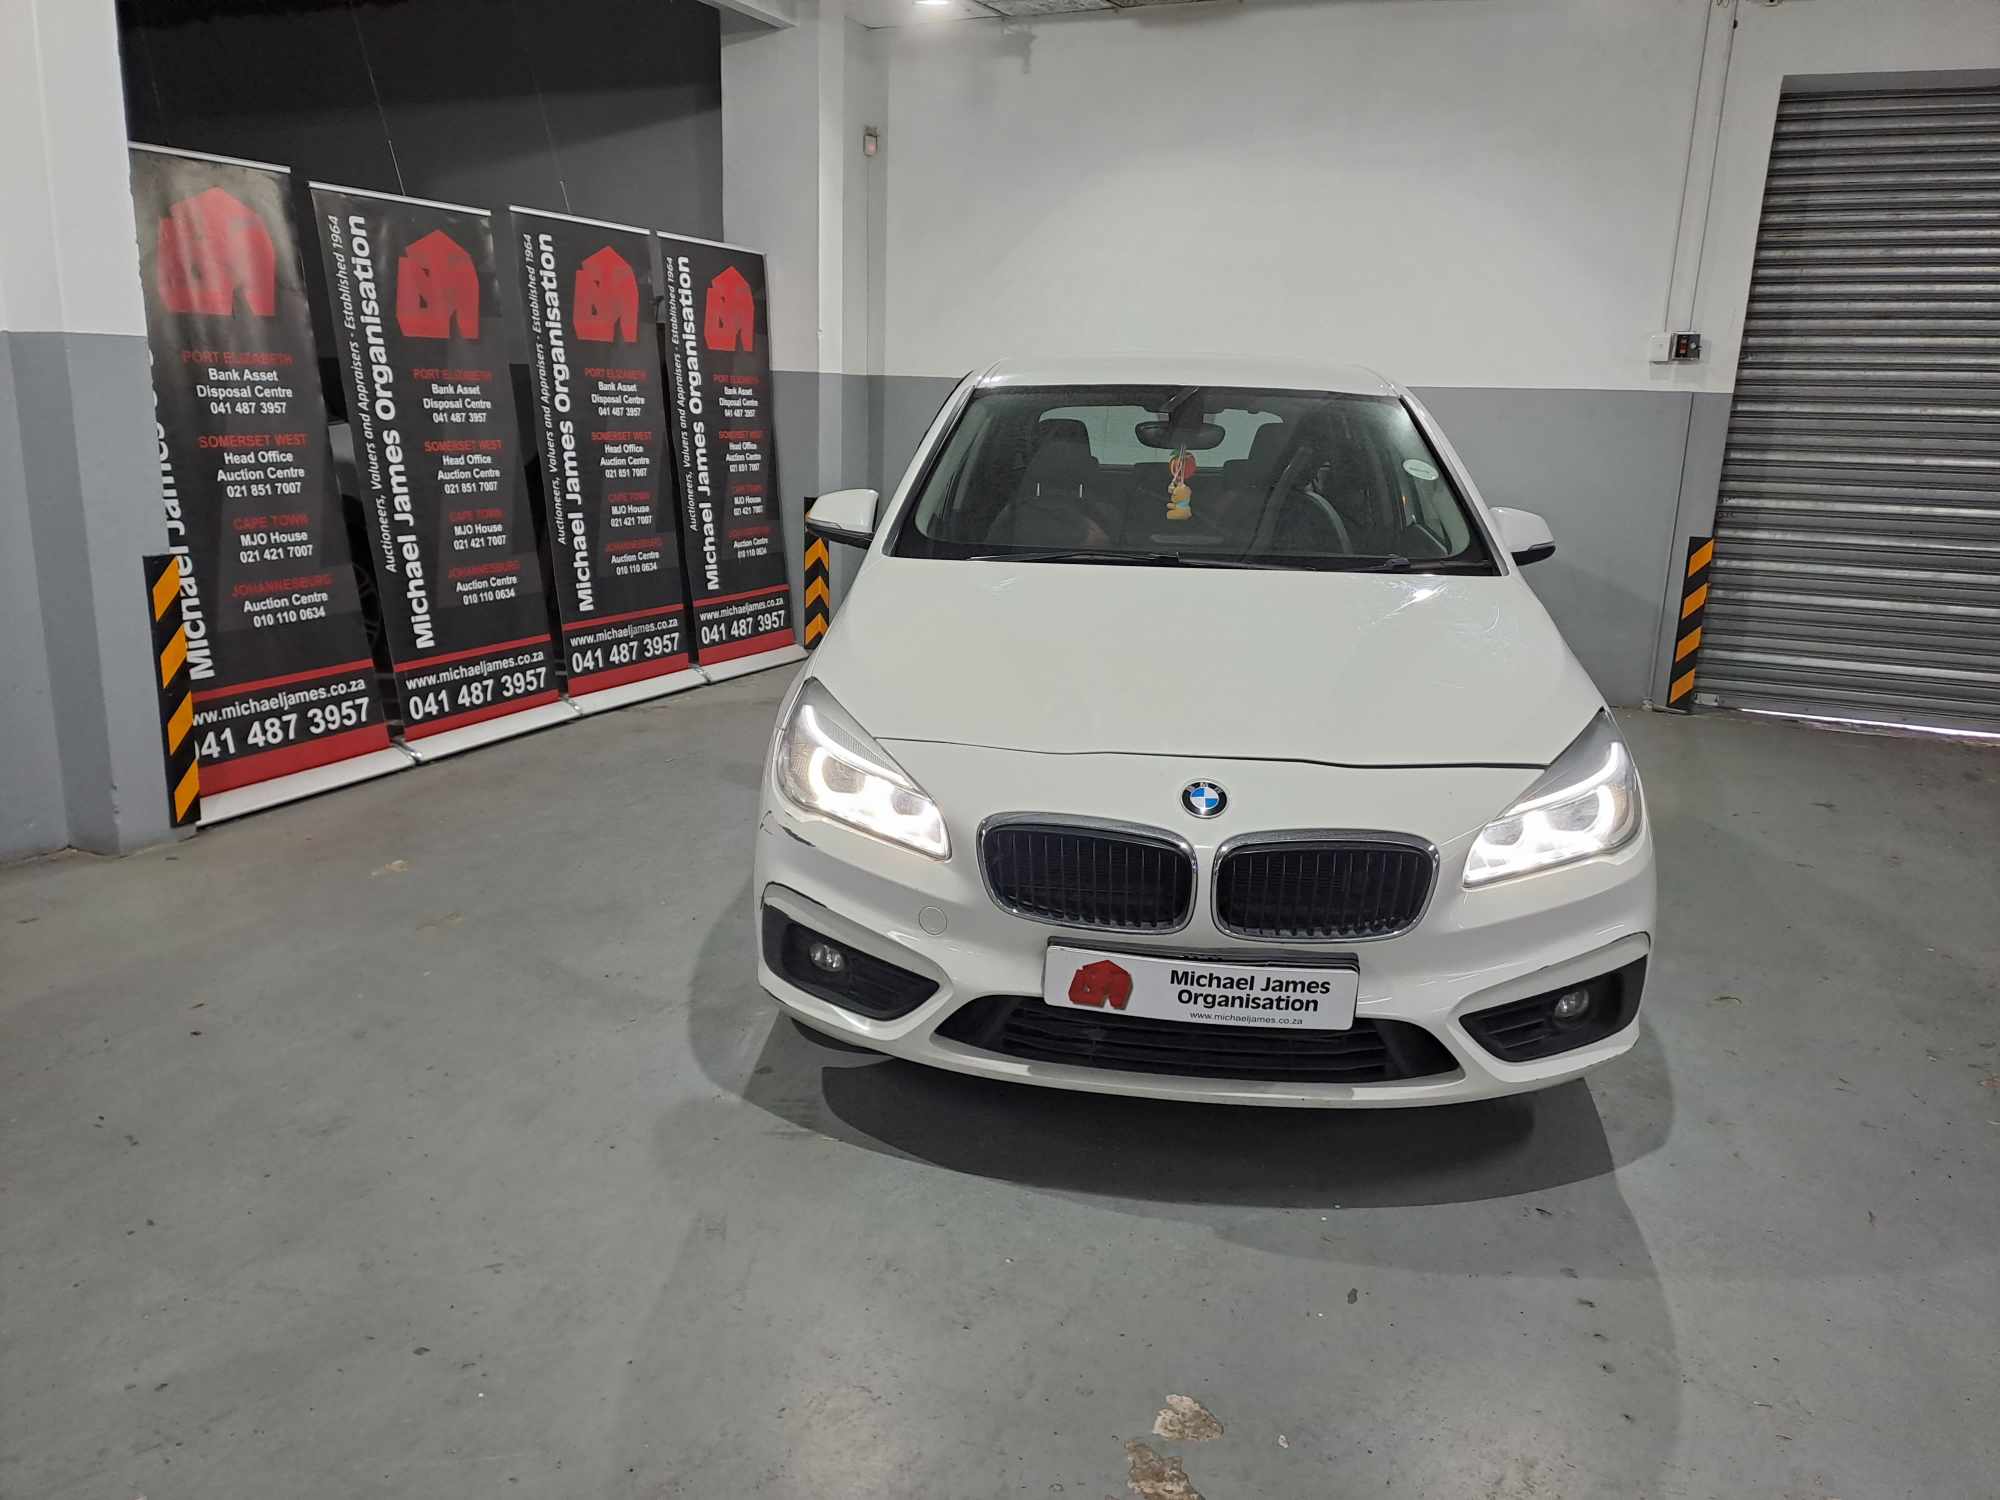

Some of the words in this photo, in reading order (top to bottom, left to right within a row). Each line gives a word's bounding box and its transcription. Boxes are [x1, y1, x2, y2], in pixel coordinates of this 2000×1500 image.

[328, 214, 343, 249] 1964
[523, 233, 534, 263] 1964
[333, 251, 356, 329] Established
[526, 265, 542, 333] Established
[349, 215, 397, 421] Organisation
[538, 233, 571, 413] Organisation
[678, 256, 703, 415] Organisation
[182, 351, 219, 364] PORT
[208, 368, 240, 381] Bank
[243, 369, 279, 381] Asset
[350, 341, 369, 411] Appraisers
[536, 343, 550, 404] Appraisers
[196, 385, 252, 400] Disposal
[255, 386, 293, 398] Centre
[432, 383, 455, 394] Bank
[457, 384, 480, 394] Asset
[210, 402, 232, 414] 041
[235, 402, 256, 414] 487
[260, 402, 287, 414] 3957
[423, 398, 462, 410] Disposal
[358, 412, 373, 438] and
[433, 413, 448, 423] 041
[541, 405, 553, 429] and
[677, 408, 687, 429] and
[199, 434, 272, 448] SOMERSET
[275, 433, 307, 447] WEST
[546, 431, 558, 473] Valuers
[681, 431, 691, 468] Valuers
[224, 452, 255, 464] Head
[258, 451, 294, 463] Office
[366, 441, 382, 490] Valuers
[442, 455, 465, 465] Head
[466, 454, 492, 464] Office
[560, 420, 583, 505] James
[693, 421, 711, 496] James
[217, 468, 264, 482] Auction
[267, 467, 305, 479] Centre
[383, 429, 414, 527] James
[438, 469, 471, 480] Auction
[227, 485, 247, 498] 021
[251, 484, 272, 497] 851
[275, 482, 302, 495] 7007
[444, 483, 459, 494] 021
[551, 477, 567, 545] Auctioneers,
[240, 533, 267, 546] MJO
[270, 531, 308, 544] House
[375, 494, 398, 573] Auctioneers,
[454, 525, 473, 536] MJO
[475, 523, 503, 534] House
[240, 550, 260, 563] 021
[263, 548, 284, 560] 421
[287, 544, 313, 558] 7007
[453, 540, 468, 550] 021
[470, 537, 485, 548] 421
[699, 502, 719, 591] Michael
[568, 512, 594, 612] Michael
[397, 534, 435, 649] Michael
[456, 579, 488, 592] Auction
[479, 591, 494, 602] 110
[243, 597, 289, 613] Auction
[291, 592, 328, 606] Centre
[700, 597, 784, 621] www.michaeljames.co.za
[253, 614, 274, 628] 010
[276, 610, 297, 624] 110
[299, 606, 326, 621] 0634
[701, 622, 726, 644] 041
[731, 617, 753, 637] 487
[757, 610, 785, 632] 3957
[570, 618, 678, 647] www.michaeljames.co.za
[572, 648, 604, 673] 041
[609, 641, 638, 664] 487
[643, 632, 680, 657] 3957
[406, 651, 544, 690] www.michaeljames.co.za
[192, 678, 366, 727] ww.michaeljames.co.za
[409, 689, 450, 720] 041
[457, 679, 494, 707] 487
[500, 667, 547, 697] 3957
[194, 727, 236, 761] 41
[247, 713, 298, 747] 487
[307, 697, 370, 734] 3957
[1170, 969, 1254, 991] Michael
[1260, 976, 1330, 994] James
[1177, 989, 1319, 1012] Organisation
[1190, 1011, 1303, 1025] www.michaeljames.co.za
